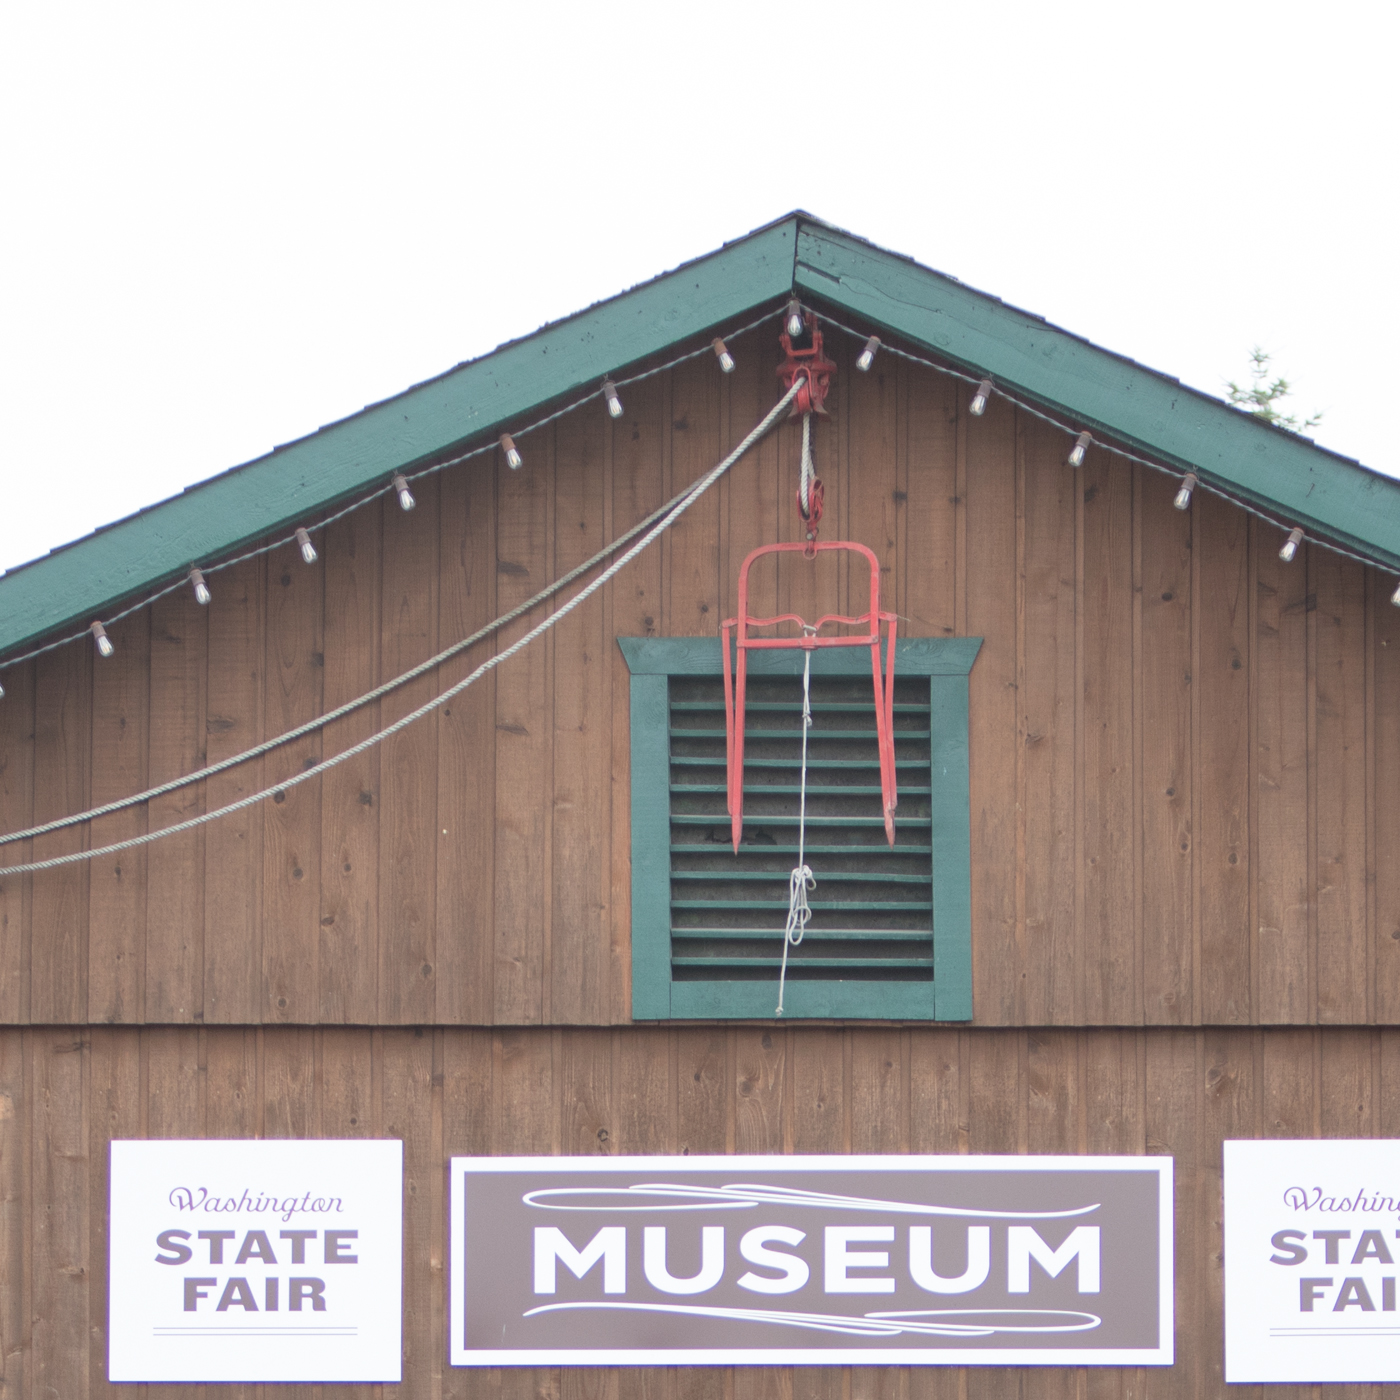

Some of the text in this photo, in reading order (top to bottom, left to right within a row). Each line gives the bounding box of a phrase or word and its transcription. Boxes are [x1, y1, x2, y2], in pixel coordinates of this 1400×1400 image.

[169, 1186, 344, 1222] Washington
[154, 1228, 359, 1266] STATE
[533, 1225, 1101, 1295] MUSEUM
[183, 1276, 327, 1312] FAIR
